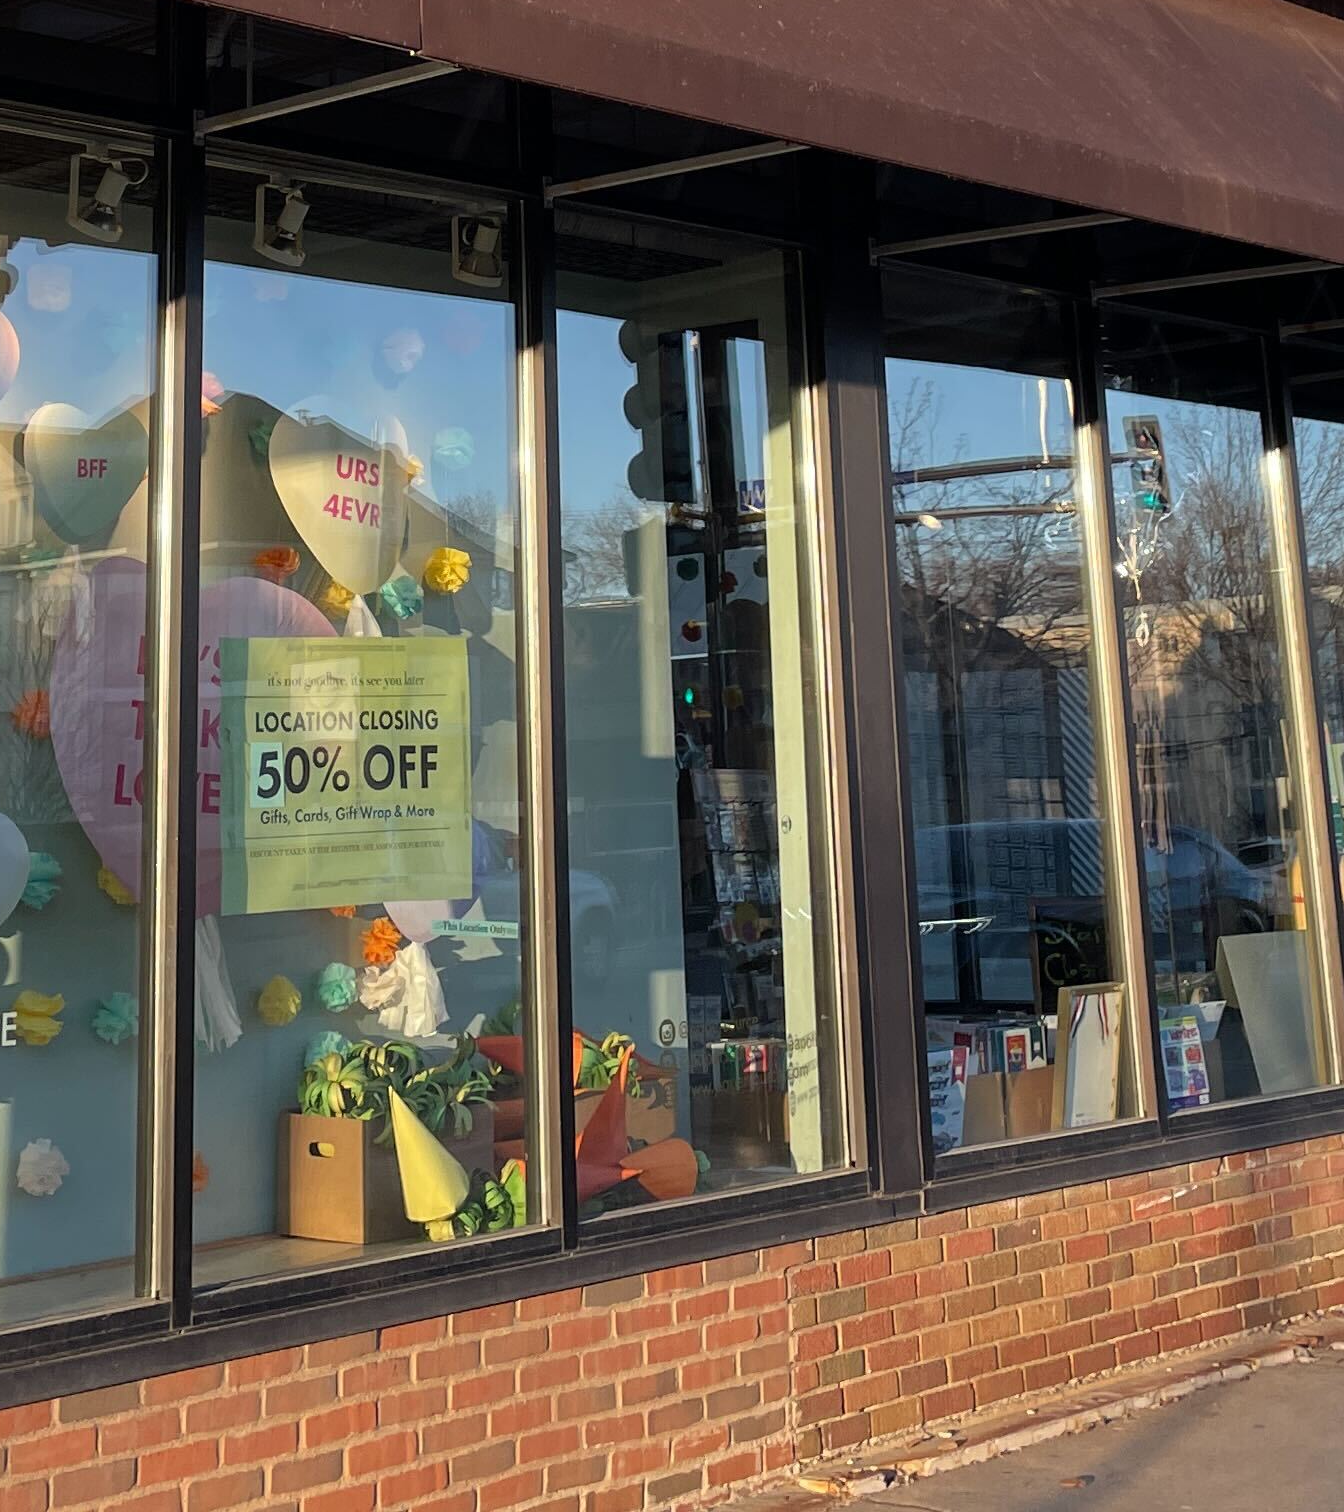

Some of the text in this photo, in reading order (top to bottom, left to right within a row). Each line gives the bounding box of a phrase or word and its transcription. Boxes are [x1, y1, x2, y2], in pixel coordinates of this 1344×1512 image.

[77, 458, 107, 479] BFF
[335, 453, 380, 487] URS
[322, 493, 381, 530] 4EVR
[284, 675, 303, 687] not
[366, 677, 382, 687] see
[384, 677, 402, 690] you
[256, 709, 439, 733] LOCATION CLOSING
[257, 744, 439, 800] 50% OFF
[260, 804, 435, 826] Gifts, Cards, Gift Wrap & More
[442, 920, 457, 931] This
[489, 924, 506, 936] Only
